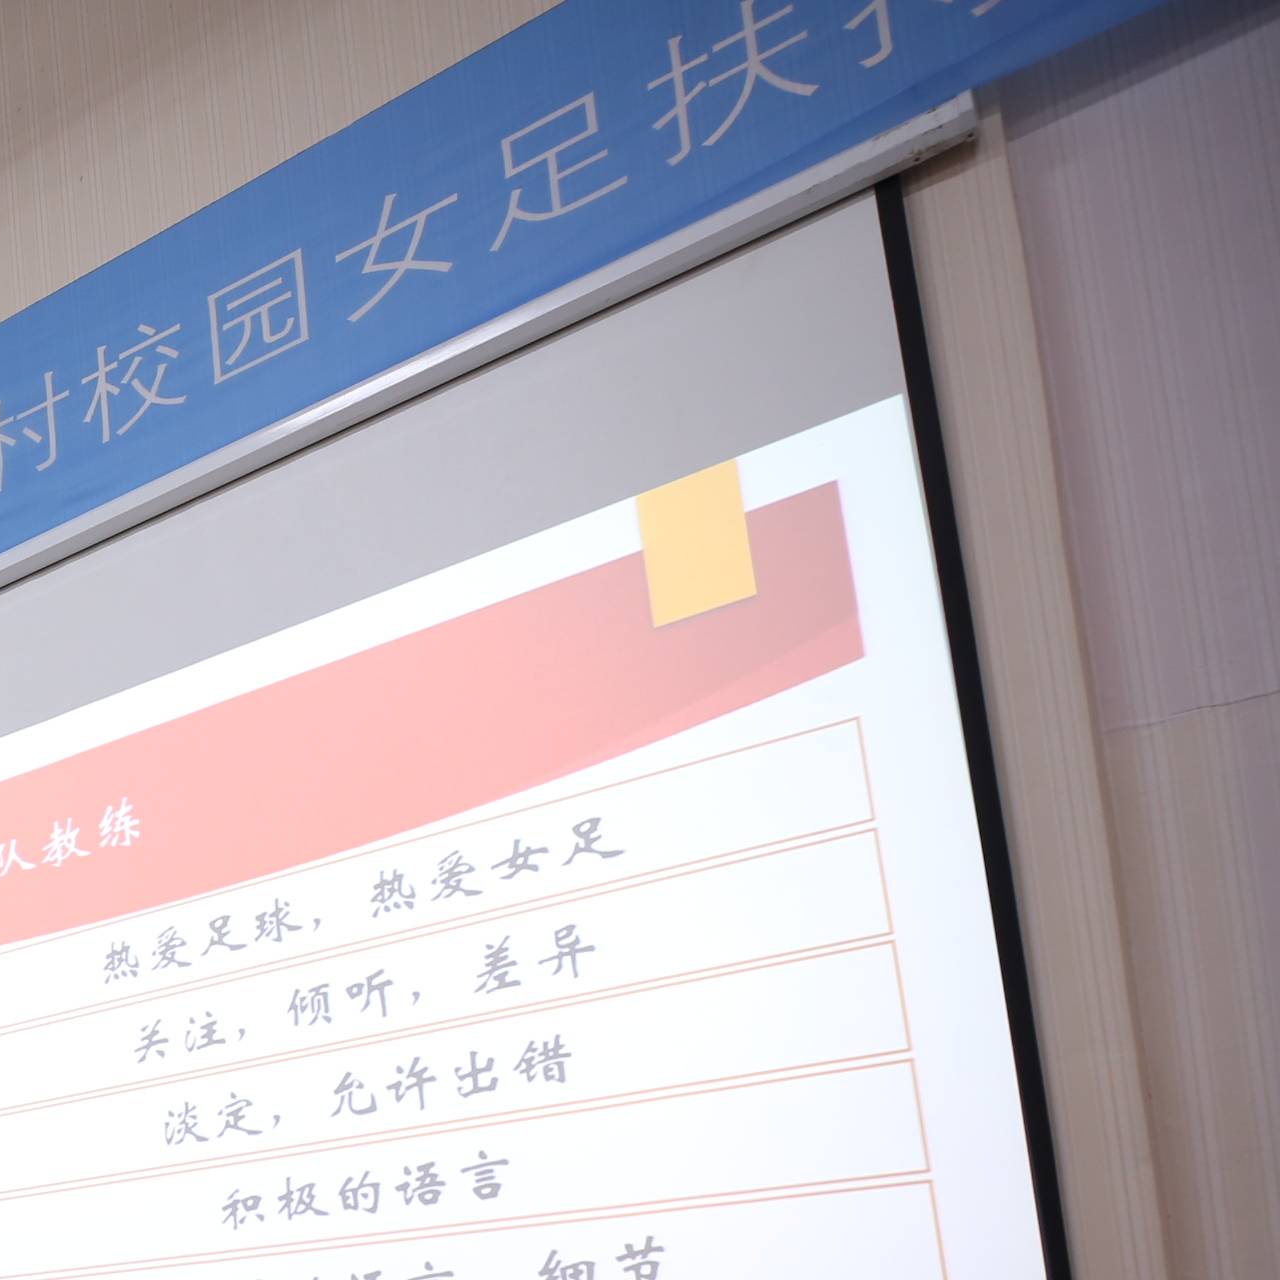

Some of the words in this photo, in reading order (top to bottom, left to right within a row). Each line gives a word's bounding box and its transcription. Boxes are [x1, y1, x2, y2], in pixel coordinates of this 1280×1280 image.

[221, 1150, 510, 1231] 积极的语言
